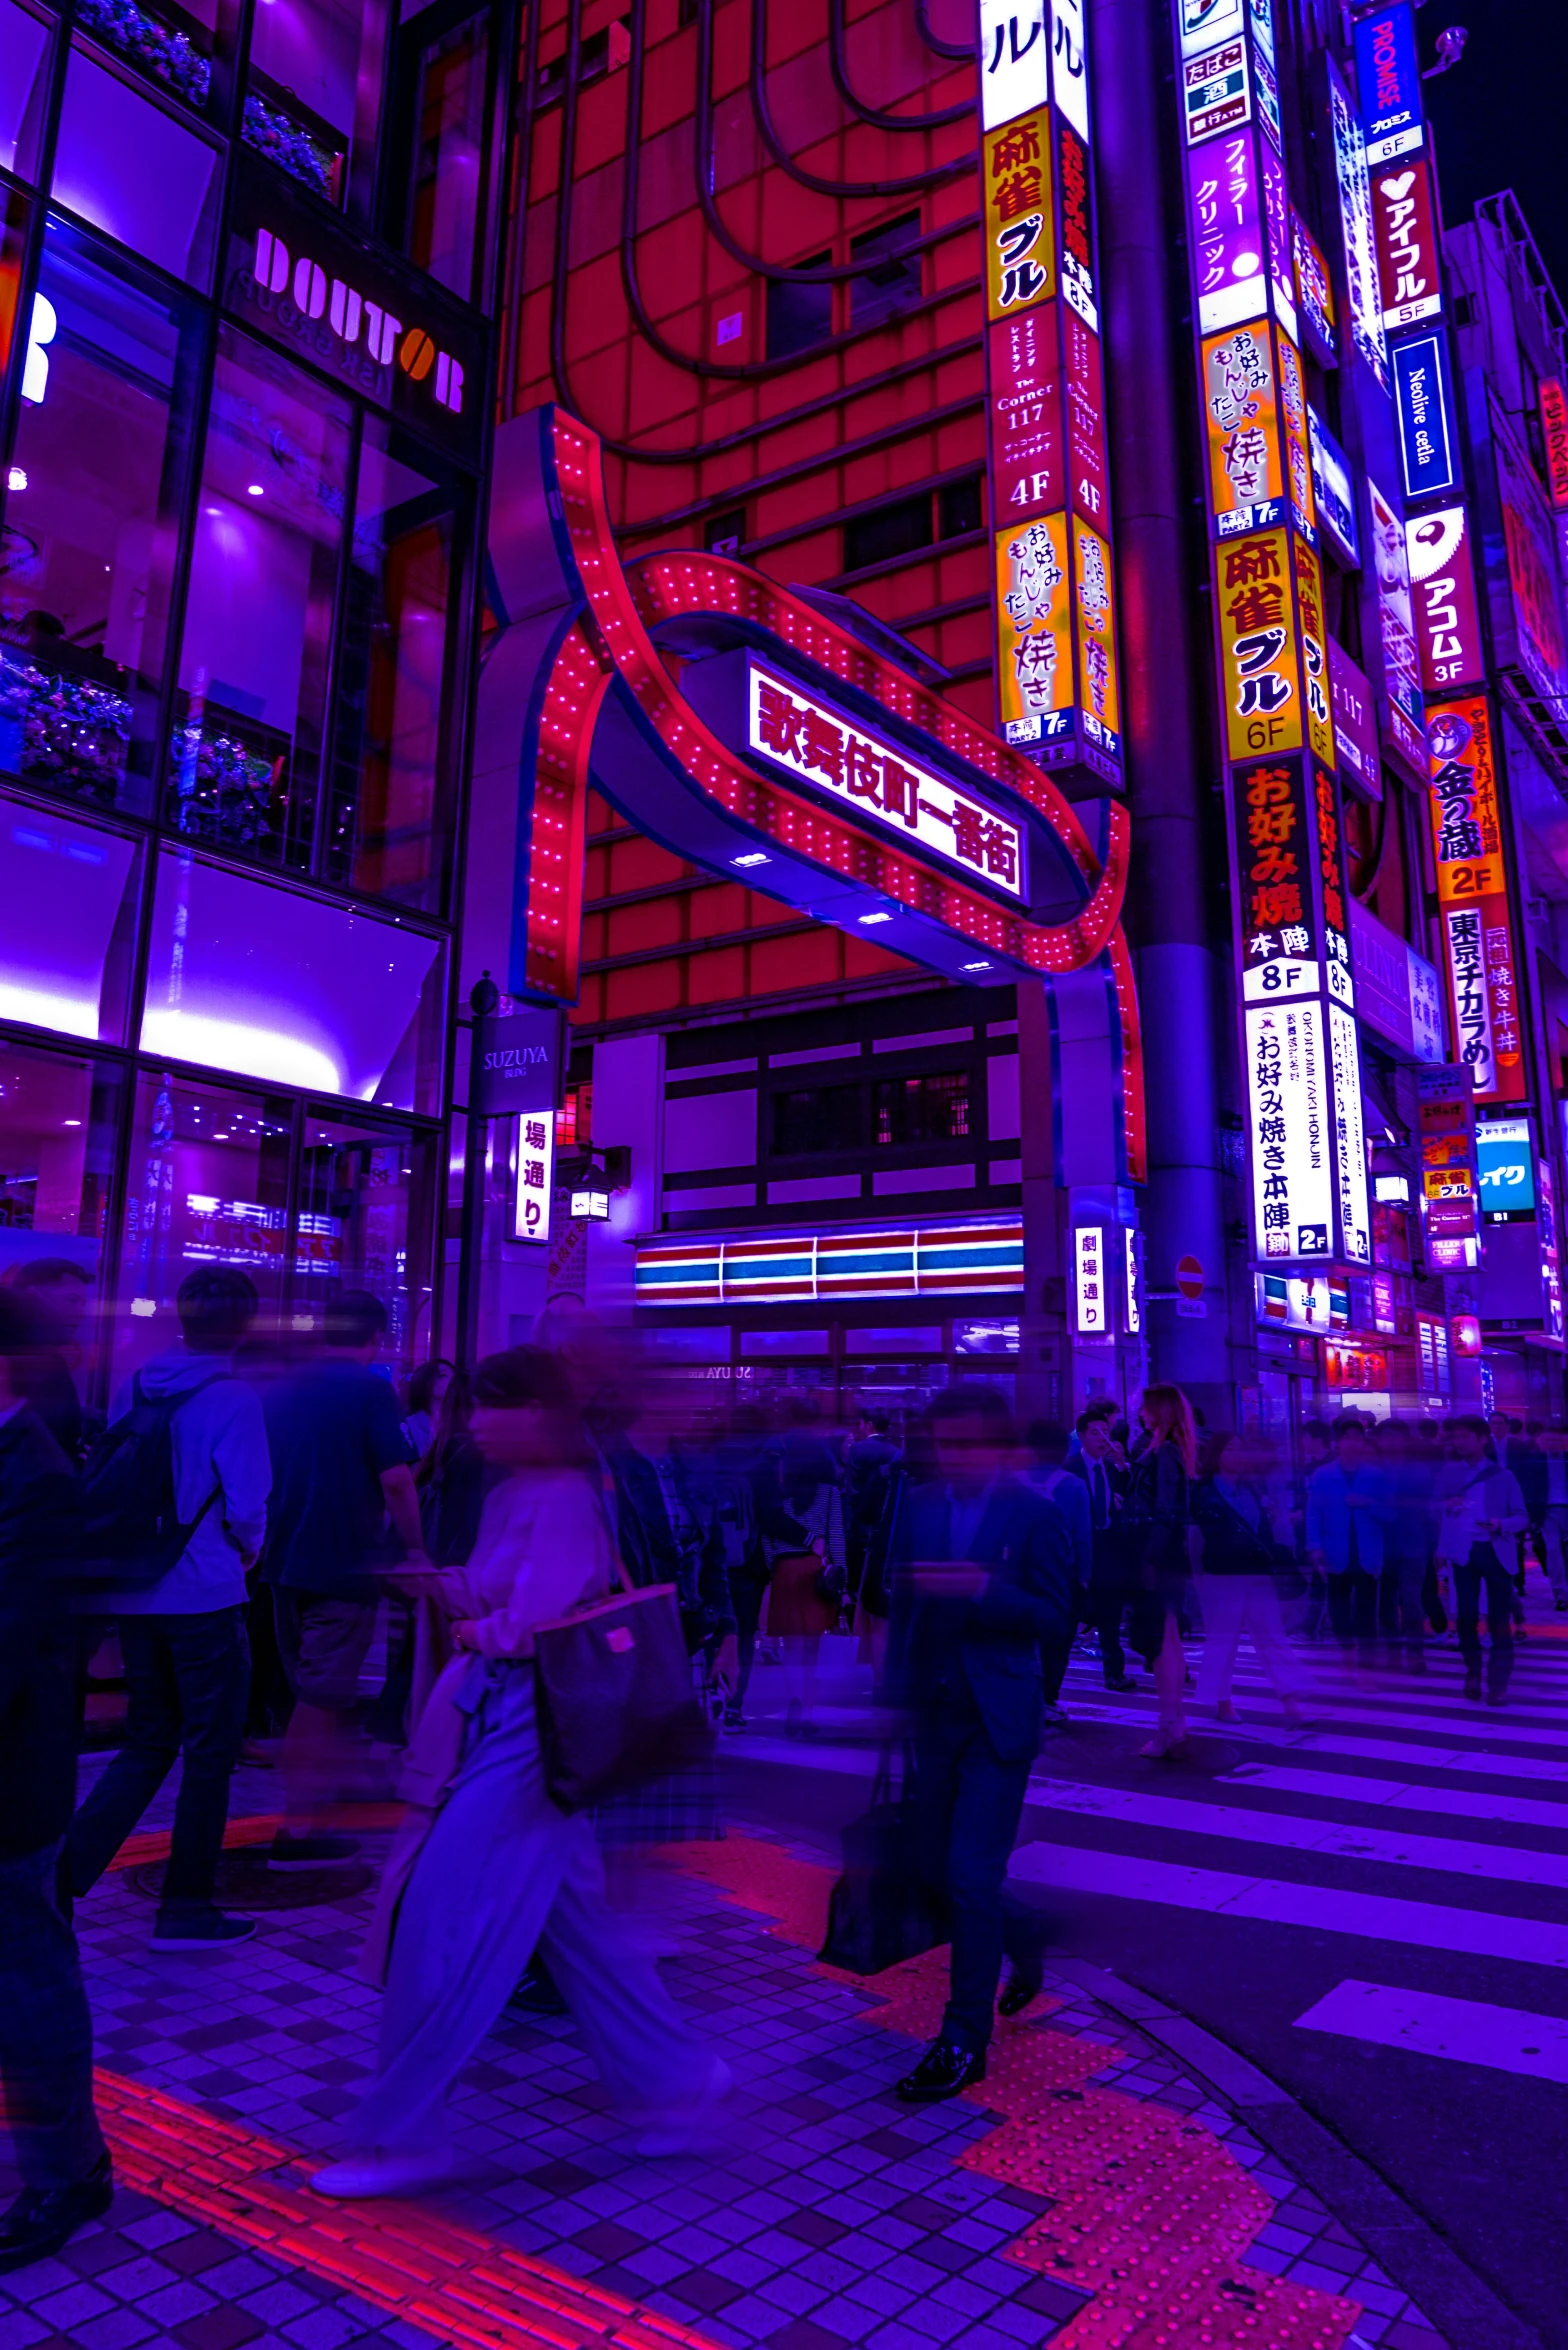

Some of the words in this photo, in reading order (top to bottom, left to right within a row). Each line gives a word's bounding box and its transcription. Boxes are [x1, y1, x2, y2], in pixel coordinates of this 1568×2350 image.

[1055, 0, 1083, 78] ル
[1188, 47, 1241, 85] たばこ
[1371, 20, 1400, 110] PROMISE
[1203, 77, 1229, 104] 酒
[1371, 110, 1412, 134] プロミス
[1382, 136, 1405, 156] 6F
[1225, 138, 1248, 225] フィラー
[1195, 180, 1225, 291] クリニック
[1385, 197, 1426, 302] アイフル
[254, 227, 464, 413] DOUTOR
[1399, 303, 1425, 321] 5F
[1010, 326, 1021, 373] レストラン
[1232, 332, 1269, 389] お好み
[997, 384, 1053, 411] Corner
[1015, 378, 1035, 389] The
[1214, 350, 1260, 419] もんじゃ
[1409, 367, 1429, 425] Neolive
[1007, 403, 1043, 430] 117
[1211, 396, 1241, 432] たこ
[1221, 427, 1267, 498] 焼き
[1415, 430, 1435, 466] cetla
[1009, 470, 1051, 506] 4F
[1078, 478, 1101, 514] 4F
[1255, 502, 1279, 524] 7F
[1027, 524, 1064, 587] お好み
[1010, 542, 1051, 619] もんじゃ
[1005, 593, 1033, 633] たこ
[1424, 577, 1463, 660] アコム
[1013, 629, 1057, 708] 焼き
[1434, 661, 1463, 682] 3F
[1044, 711, 1067, 736] 7F
[1102, 728, 1116, 752] 7F
[1247, 716, 1285, 750] 6F
[758, 680, 1017, 885] 歌舞伎町一番街
[1431, 760, 1484, 863] 金の蔵
[1246, 767, 1303, 928] お好み焼
[1451, 866, 1491, 895] 2F
[1250, 925, 1309, 958] 本陣
[1262, 964, 1302, 991] 8F
[1331, 963, 1347, 997] 8F
[1449, 913, 1491, 1090] 東京チカラめし
[484, 1046, 549, 1070] SUZUYA
[504, 1067, 527, 1079] BLDG
[1256, 1034, 1291, 1231] お好み焼き本陣
[1309, 1114, 1321, 1170] HONJIN
[524, 1119, 546, 1226] 場通り
[1441, 1184, 1469, 1196] ブル
[1493, 1211, 1508, 1221] B1
[1300, 1229, 1326, 1251] 2F
[1082, 1234, 1099, 1324] 劇場通り
